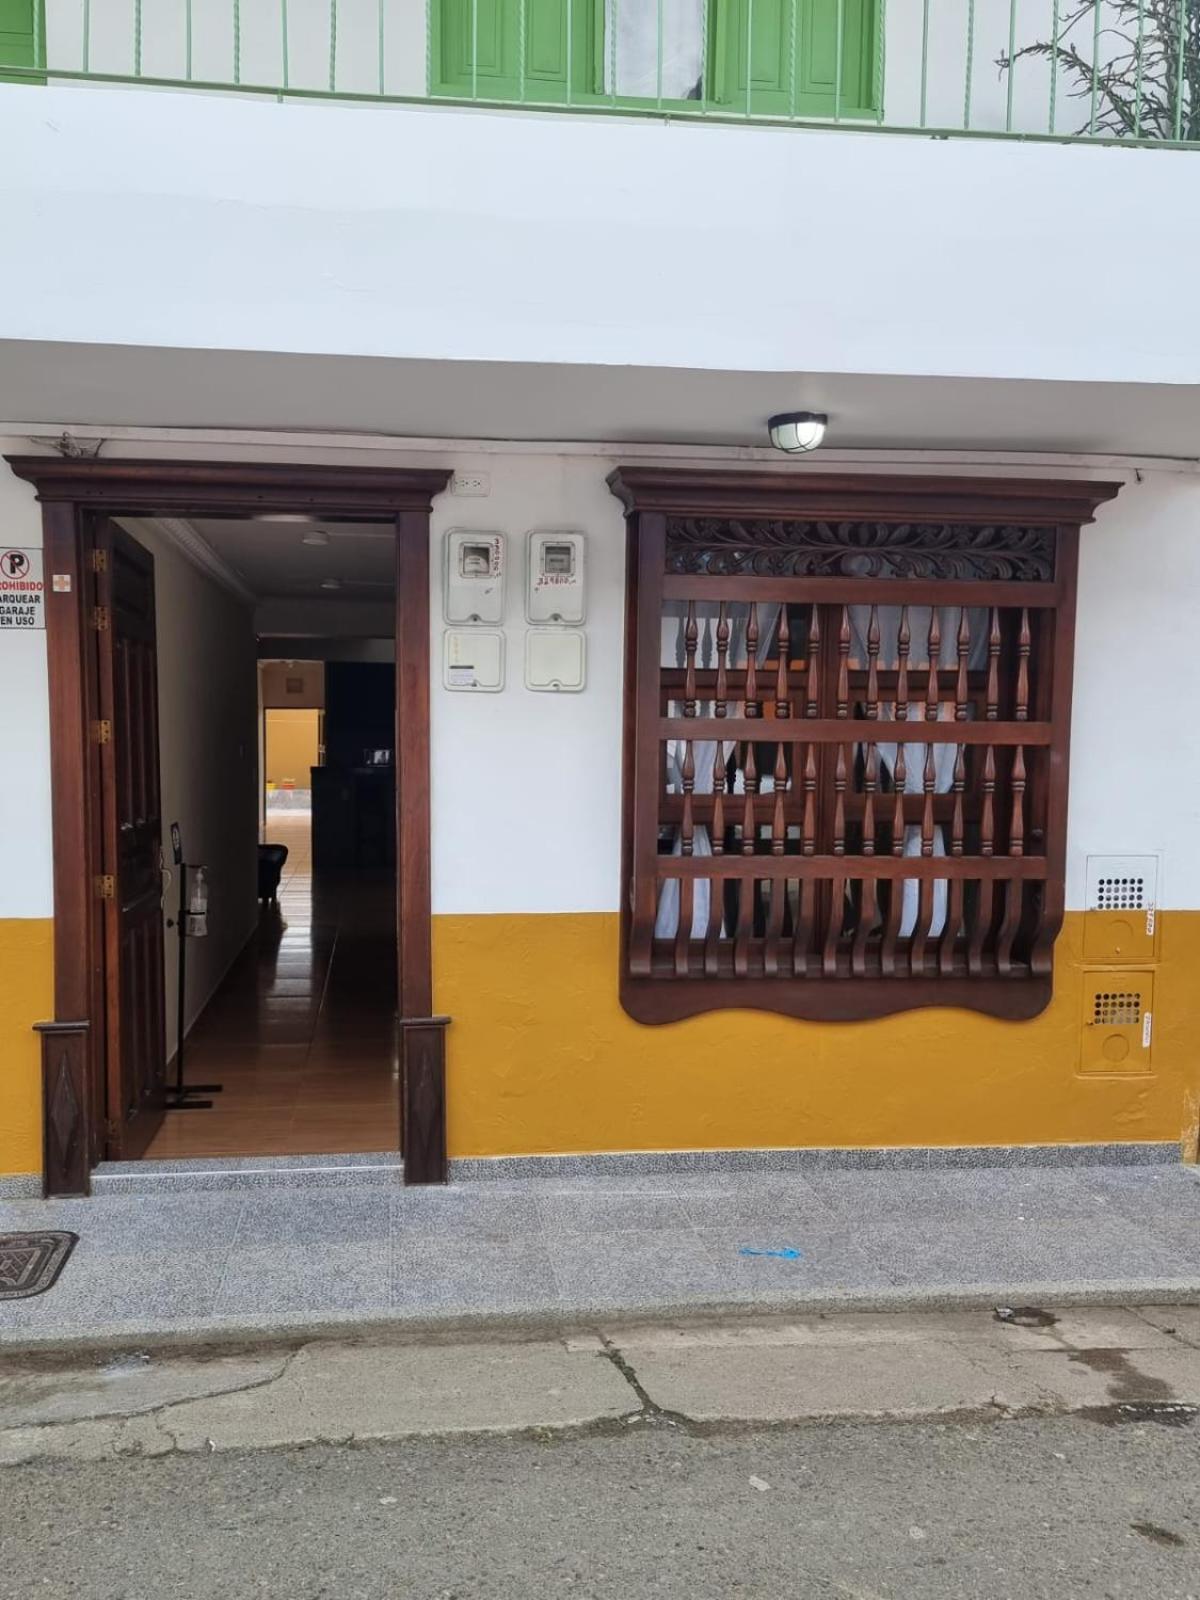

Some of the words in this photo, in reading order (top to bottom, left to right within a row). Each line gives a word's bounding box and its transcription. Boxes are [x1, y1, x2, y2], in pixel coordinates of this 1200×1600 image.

[10, 554, 24, 574] P
[0, 581, 43, 591] OHIBIDO
[0, 606, 35, 615] GARAJE
[1, 616, 12, 625] EN
[16, 616, 35, 625] USO
